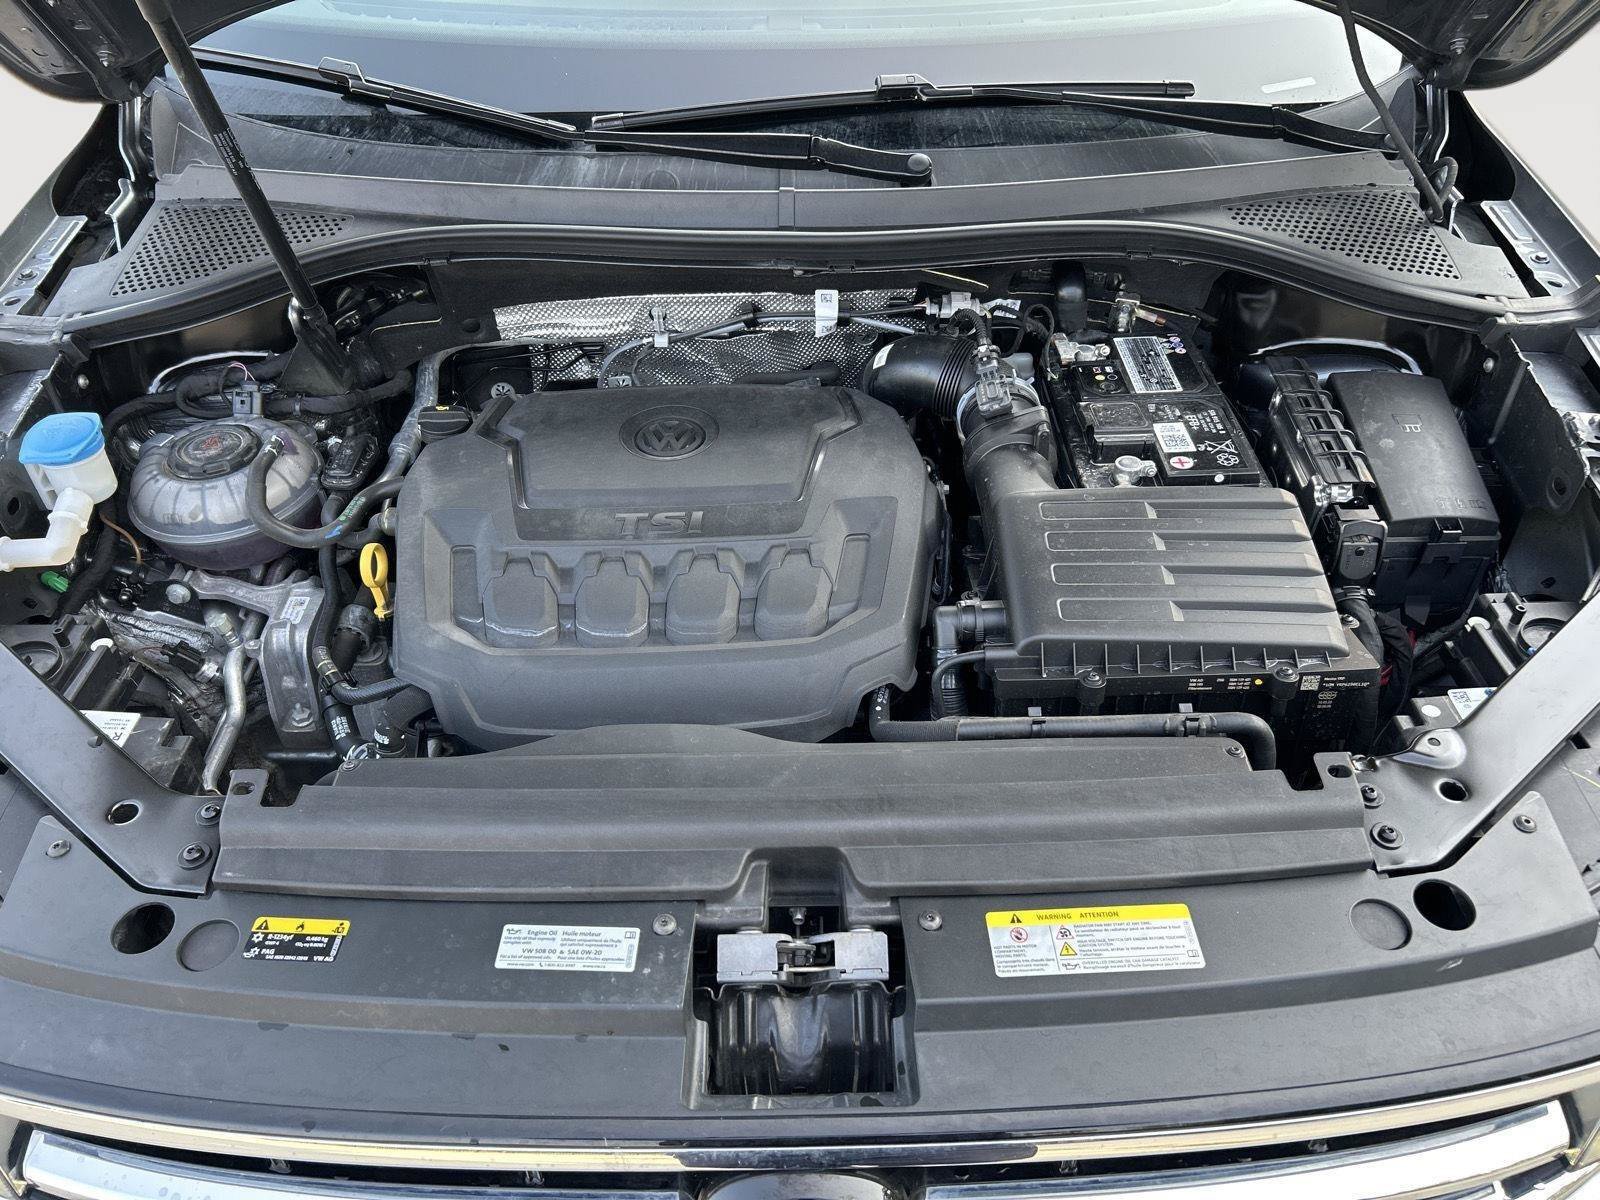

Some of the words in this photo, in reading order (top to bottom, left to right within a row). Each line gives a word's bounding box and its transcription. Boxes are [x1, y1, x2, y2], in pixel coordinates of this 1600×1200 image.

[614, 510, 704, 537] TSI
[1036, 913, 1072, 921] WARNING
[1079, 911, 1119, 919] ATTENTION
[527, 929, 548, 937] Engine
[267, 934, 294, 942] R-1234yf
